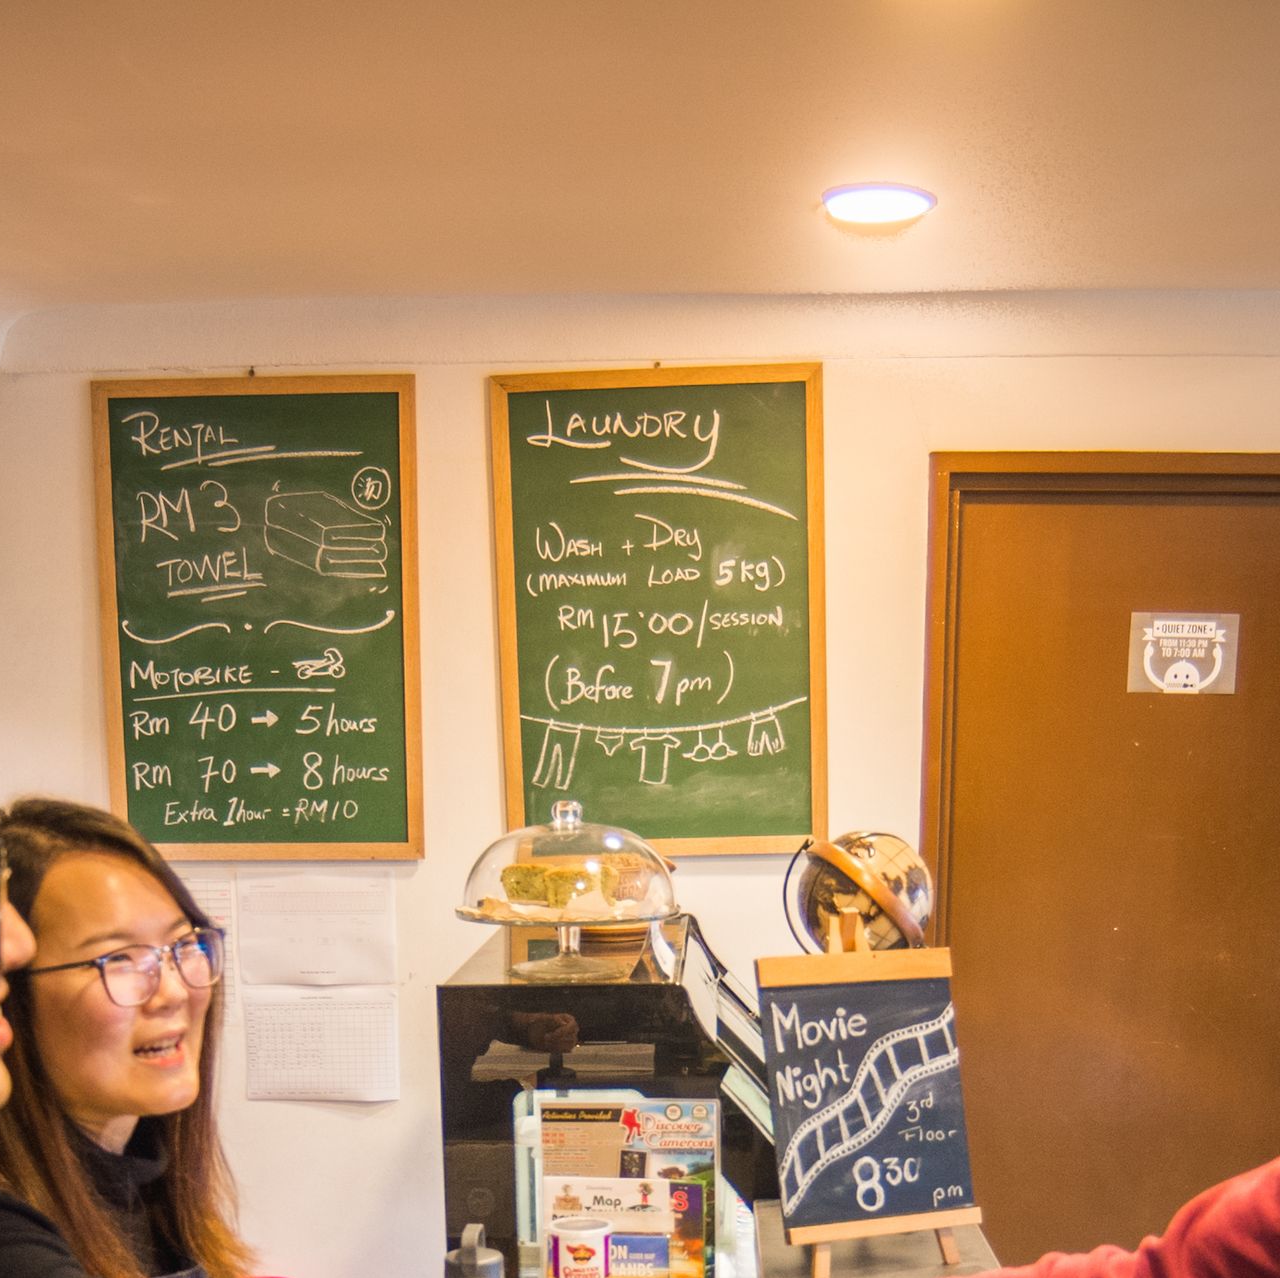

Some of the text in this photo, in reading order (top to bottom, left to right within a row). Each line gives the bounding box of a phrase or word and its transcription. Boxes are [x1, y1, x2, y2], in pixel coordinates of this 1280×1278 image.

[121, 410, 239, 464] RENTAL
[525, 399, 720, 473] LAUNDRY
[136, 479, 241, 543] RM 3
[536, 521, 603, 562] WASH
[635, 513, 703, 561] DRY
[156, 546, 264, 587] TOWEL
[647, 565, 701, 588] LOAD
[1161, 623, 1208, 634] QUIET ZONE
[129, 660, 253, 692] MOTOBIKE
[188, 702, 237, 740] 40
[197, 755, 237, 793] 70
[303, 752, 324, 791] 8
[331, 754, 390, 786] hours
[163, 799, 218, 827] Extra
[770, 1001, 868, 1053] Movie
[775, 1048, 851, 1110] Night
[592, 1195, 622, 1208] Map
[932, 1184, 963, 1208] pm
